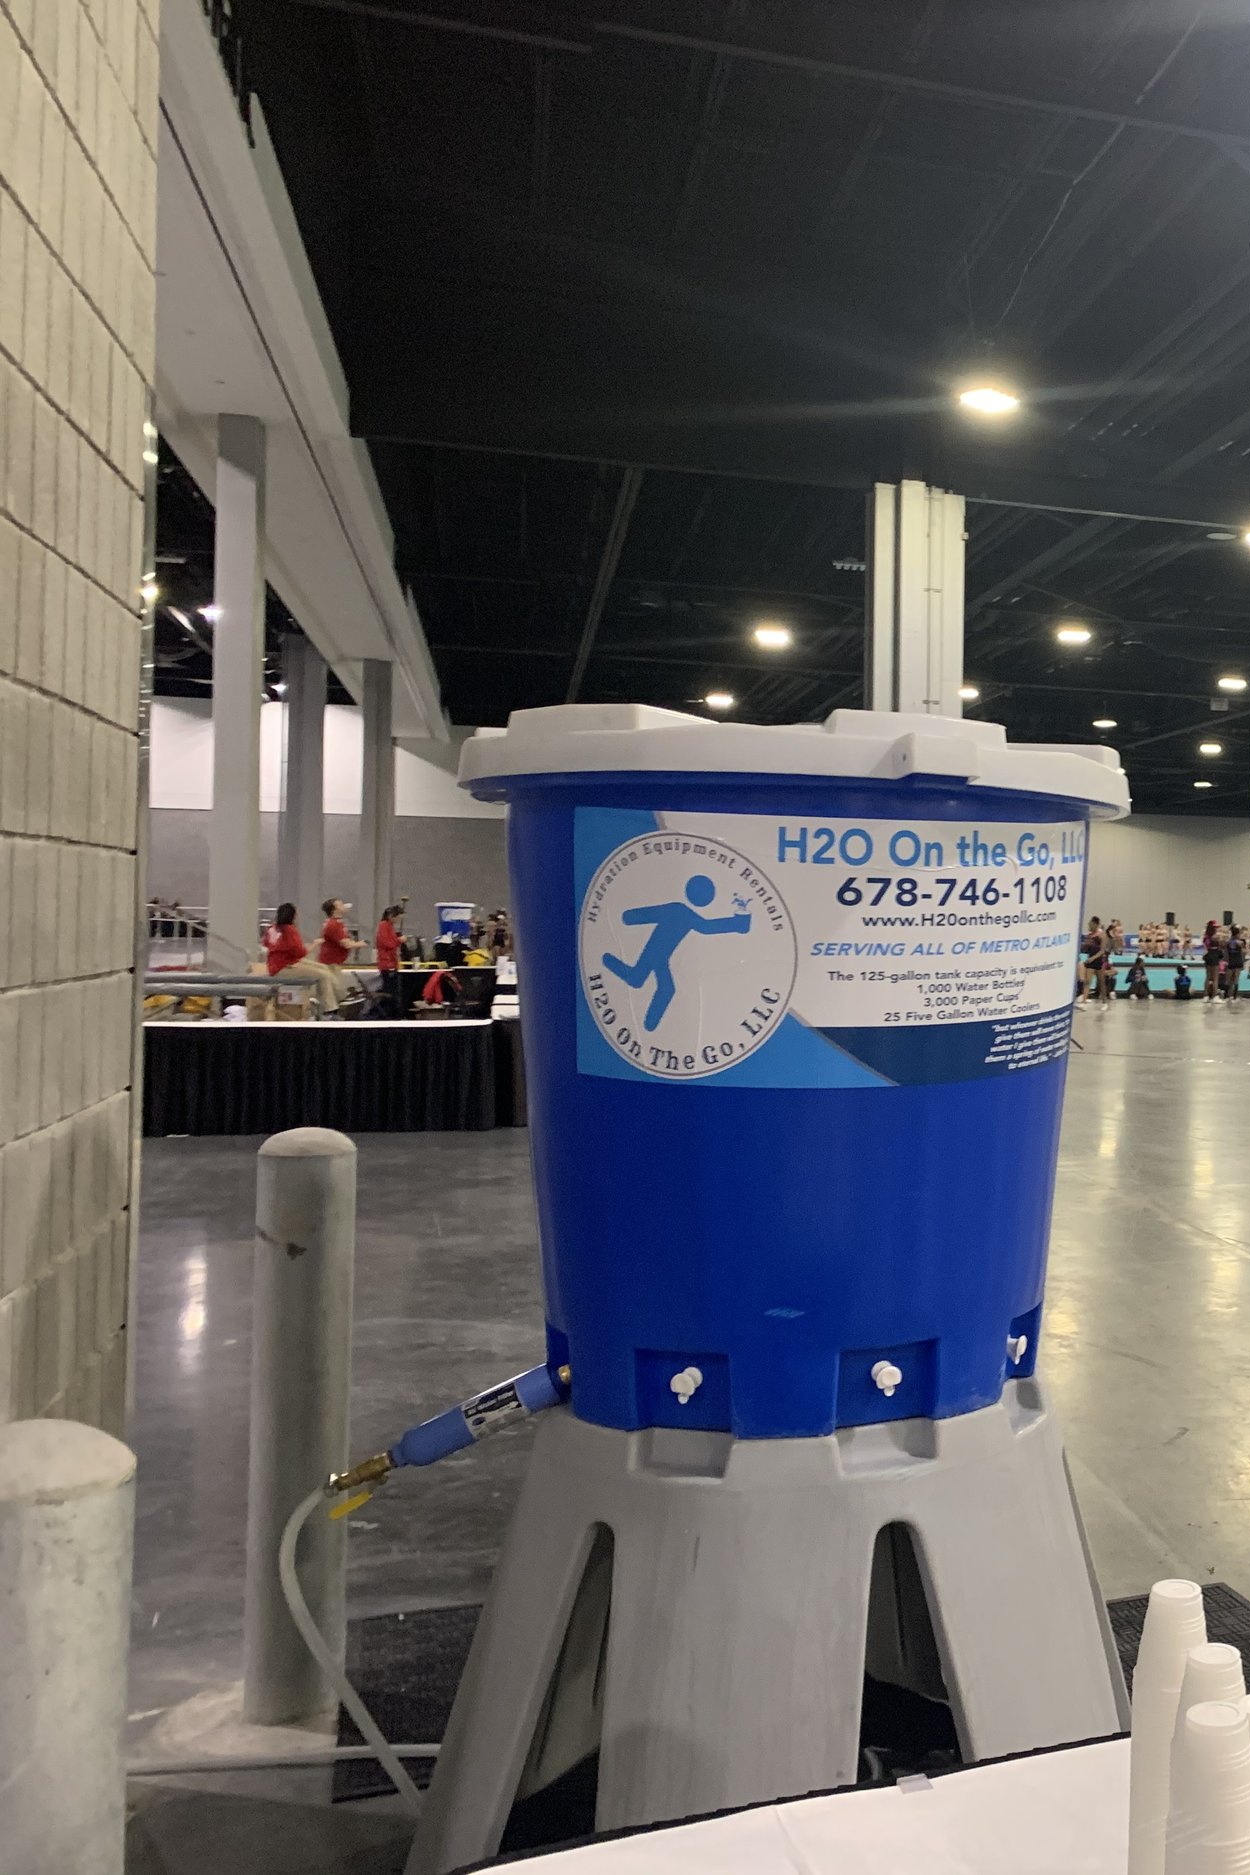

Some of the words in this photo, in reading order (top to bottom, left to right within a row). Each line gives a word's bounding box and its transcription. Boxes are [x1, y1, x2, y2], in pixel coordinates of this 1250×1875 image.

[777, 826, 873, 866] H2O
[889, 830, 943, 867] On
[956, 830, 1006, 866] the
[1017, 832, 1054, 870] Go,
[587, 851, 639, 923] Hydration
[643, 837, 736, 870] Equipment
[739, 867, 784, 932] Rentals
[836, 875, 1067, 907] 678-746-1108
[810, 942, 905, 956] SERVING
[911, 942, 945, 956] ALL
[952, 942, 976, 955] OF
[980, 938, 1030, 954] METRO
[1032, 933, 1072, 950] ATLANTA
[828, 971, 854, 981] The
[860, 971, 931, 983] 125-gallon
[935, 969, 961, 980] tank
[965, 967, 1008, 980] capacity
[1010, 966, 1018, 975] is
[916, 984, 952, 995] 1,000
[956, 981, 989, 993] Water
[992, 979, 1025, 990] Bottles
[884, 1012, 900, 1022] 25
[906, 1011, 933, 1021] Five
[937, 1008, 975, 1020] Gallon
[978, 1006, 1008, 1018] Water
[1010, 1002, 1041, 1014] Coolers
[924, 997, 958, 1008] 3,000
[961, 995, 993, 1007] Paper
[997, 993, 1019, 1004] Cups
[617, 1027, 642, 1057] On
[649, 1046, 695, 1070] The
[702, 1041, 745, 1065] Go,
[740, 988, 780, 1038] LLC
